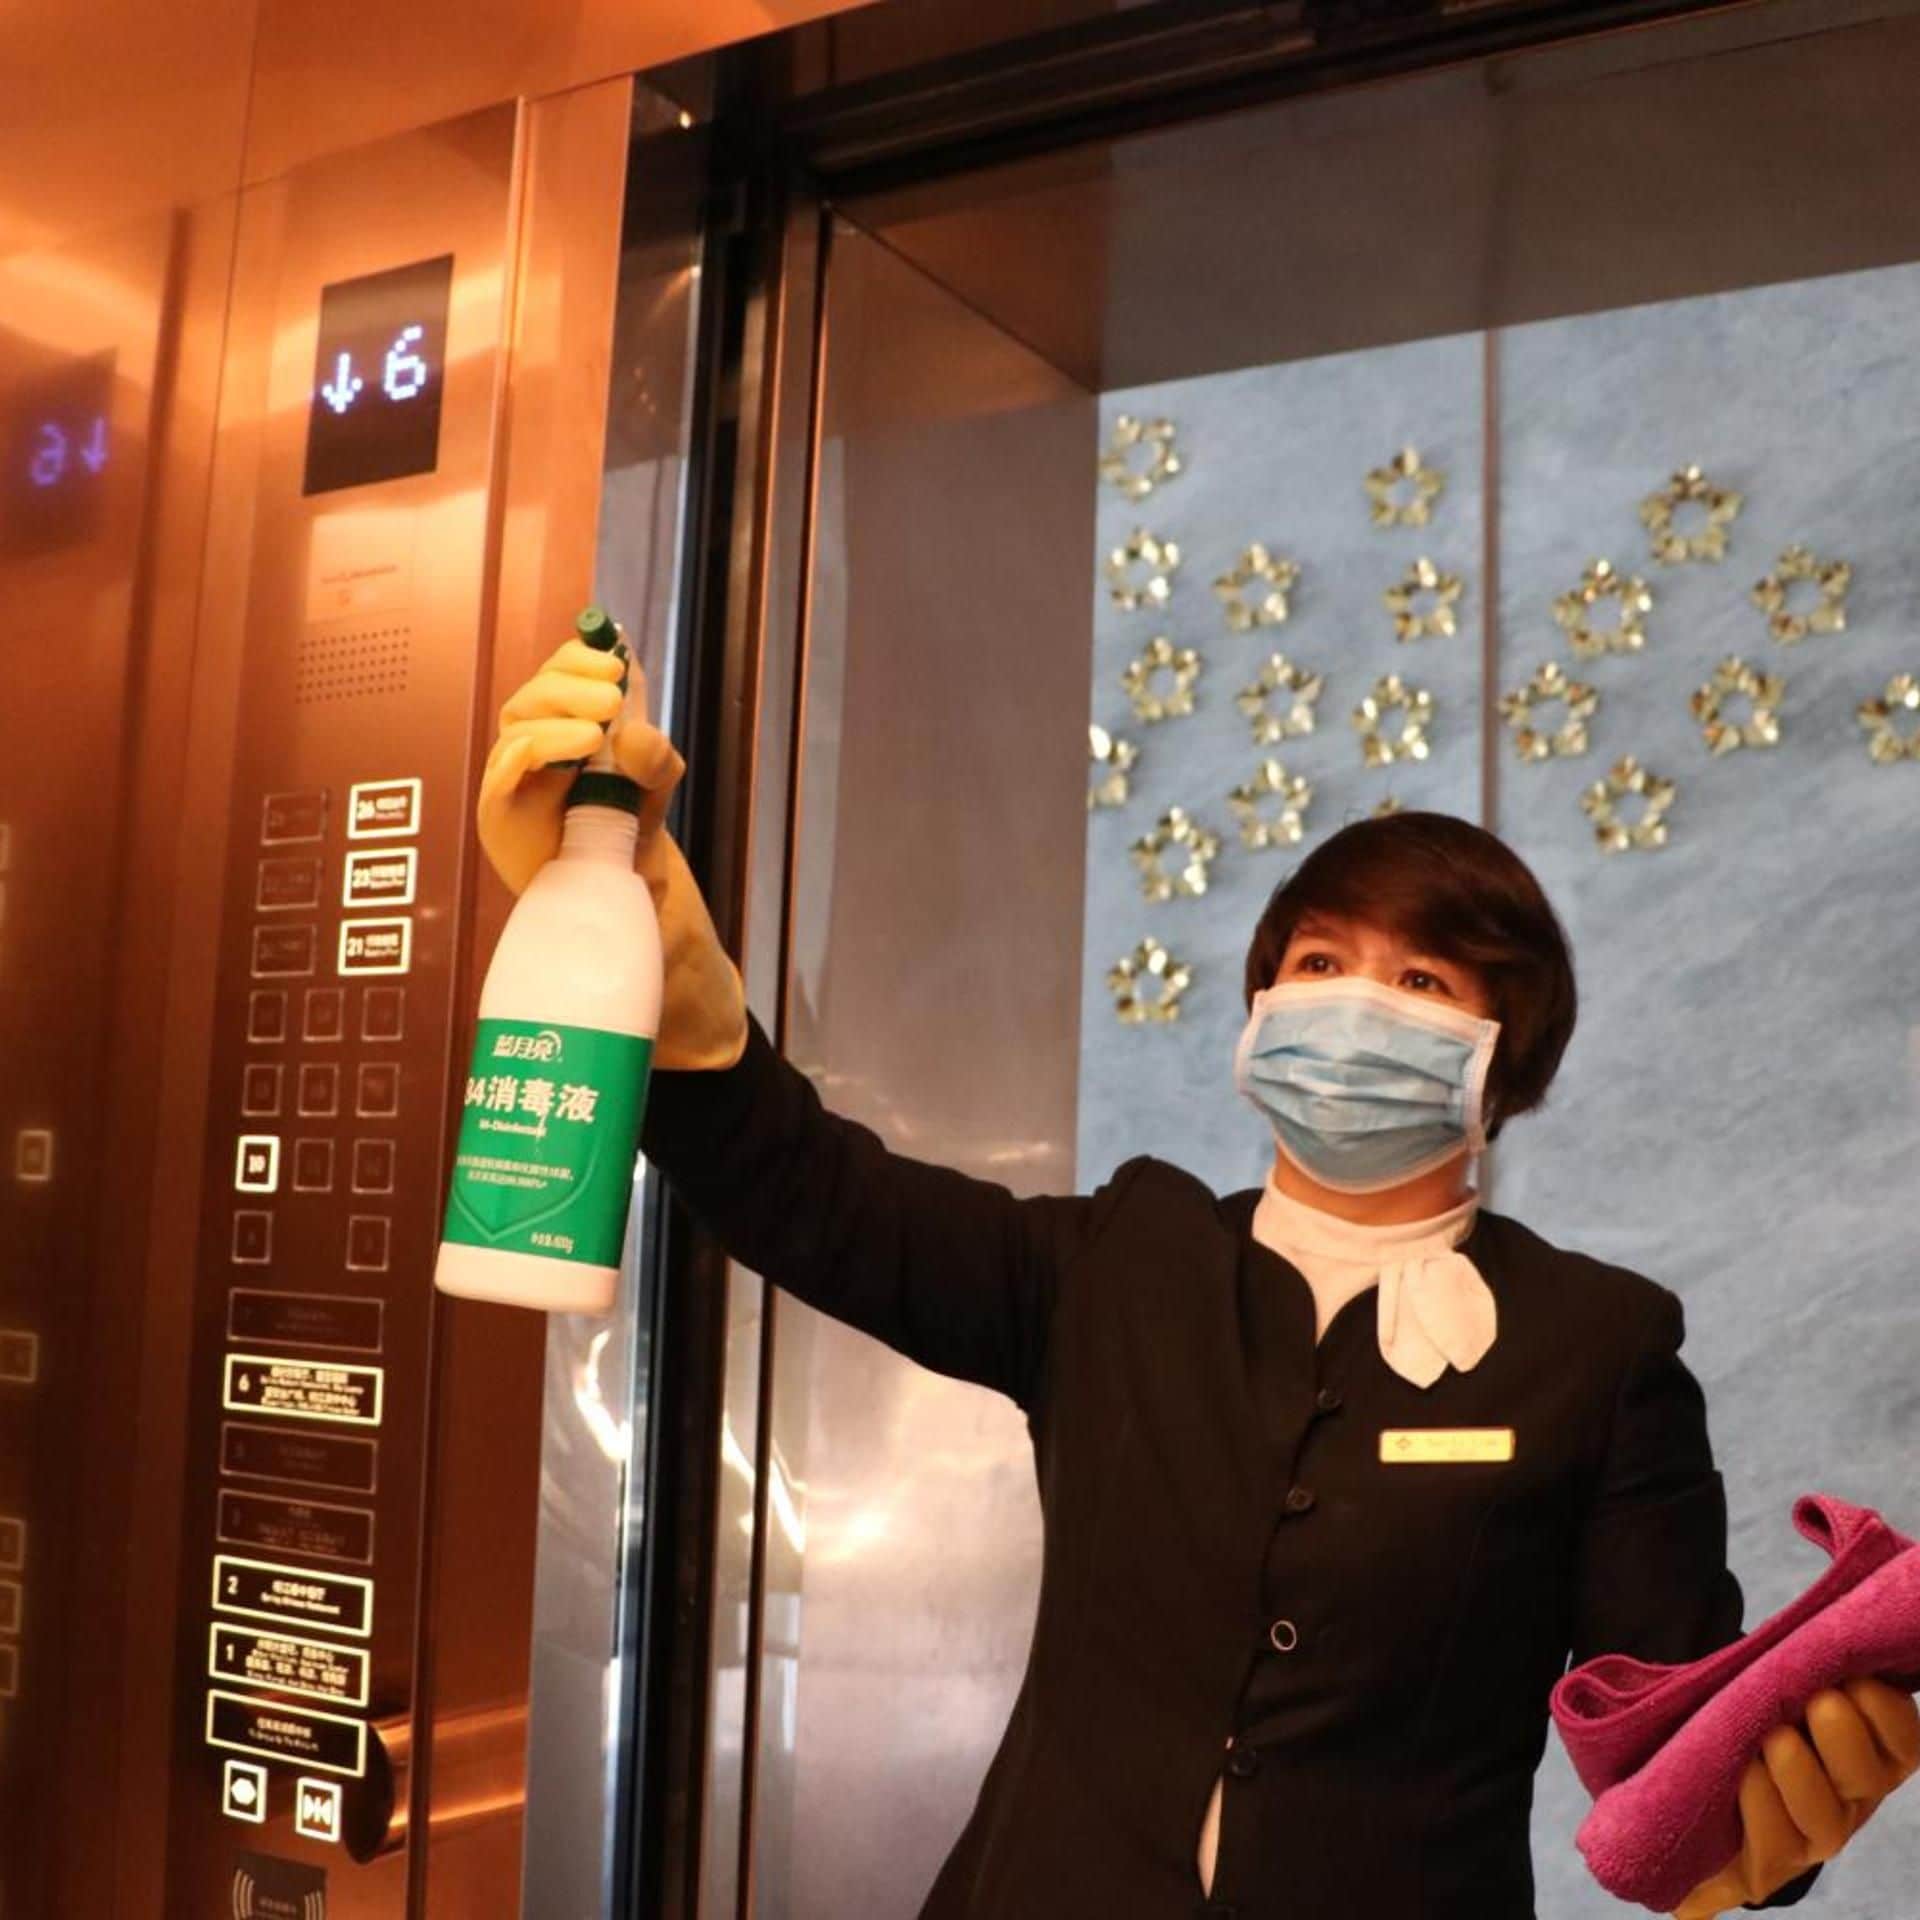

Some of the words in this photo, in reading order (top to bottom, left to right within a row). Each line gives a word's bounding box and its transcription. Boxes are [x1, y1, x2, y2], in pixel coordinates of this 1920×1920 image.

[384, 325, 427, 401] 6
[238, 1373, 251, 1393] 6
[227, 1575, 239, 1596] 2
[225, 1643, 235, 1662] 1
